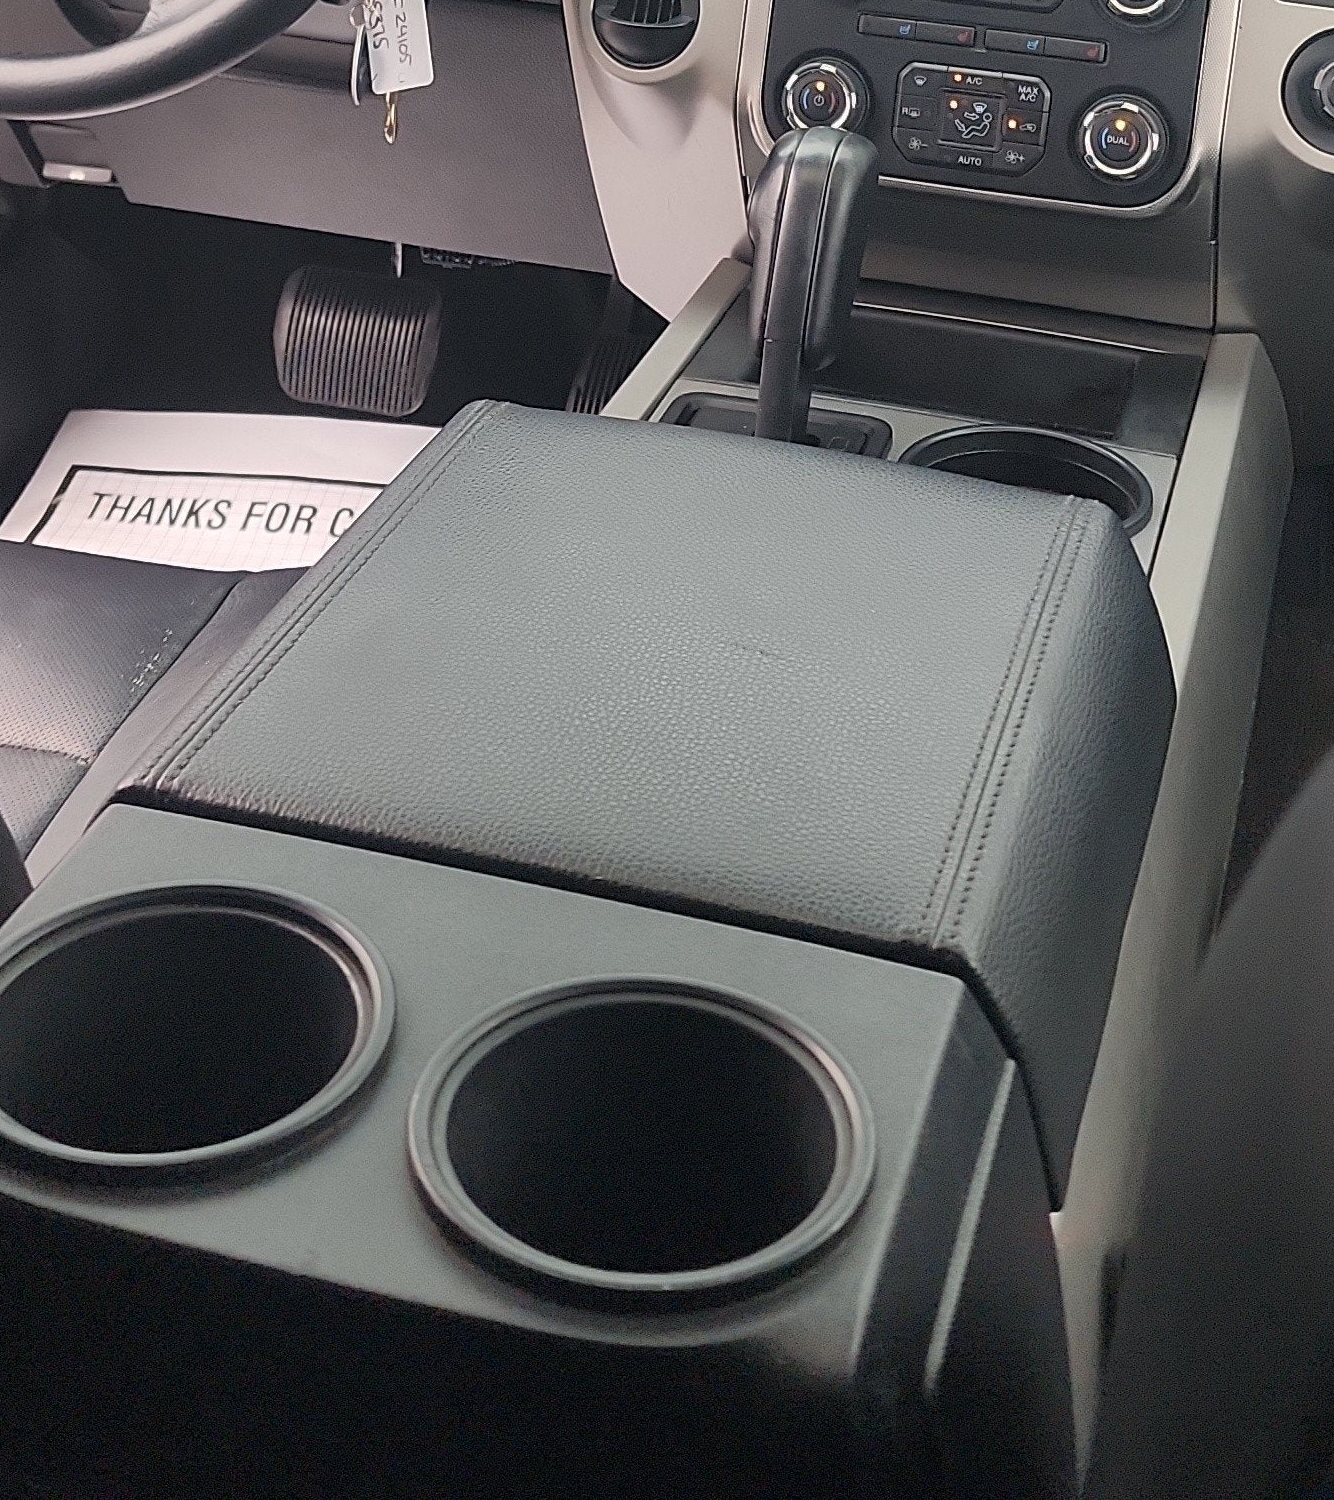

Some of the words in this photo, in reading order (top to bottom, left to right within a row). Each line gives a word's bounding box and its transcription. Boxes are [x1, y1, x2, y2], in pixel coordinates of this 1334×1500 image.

[966, 77, 983, 86] A/C
[1018, 85, 1039, 96] MAX
[1019, 94, 1037, 103] A/C
[1107, 134, 1130, 146] DUAL
[957, 155, 982, 167] AUTO
[87, 491, 233, 531] THANKS
[239, 500, 317, 535] FOR
